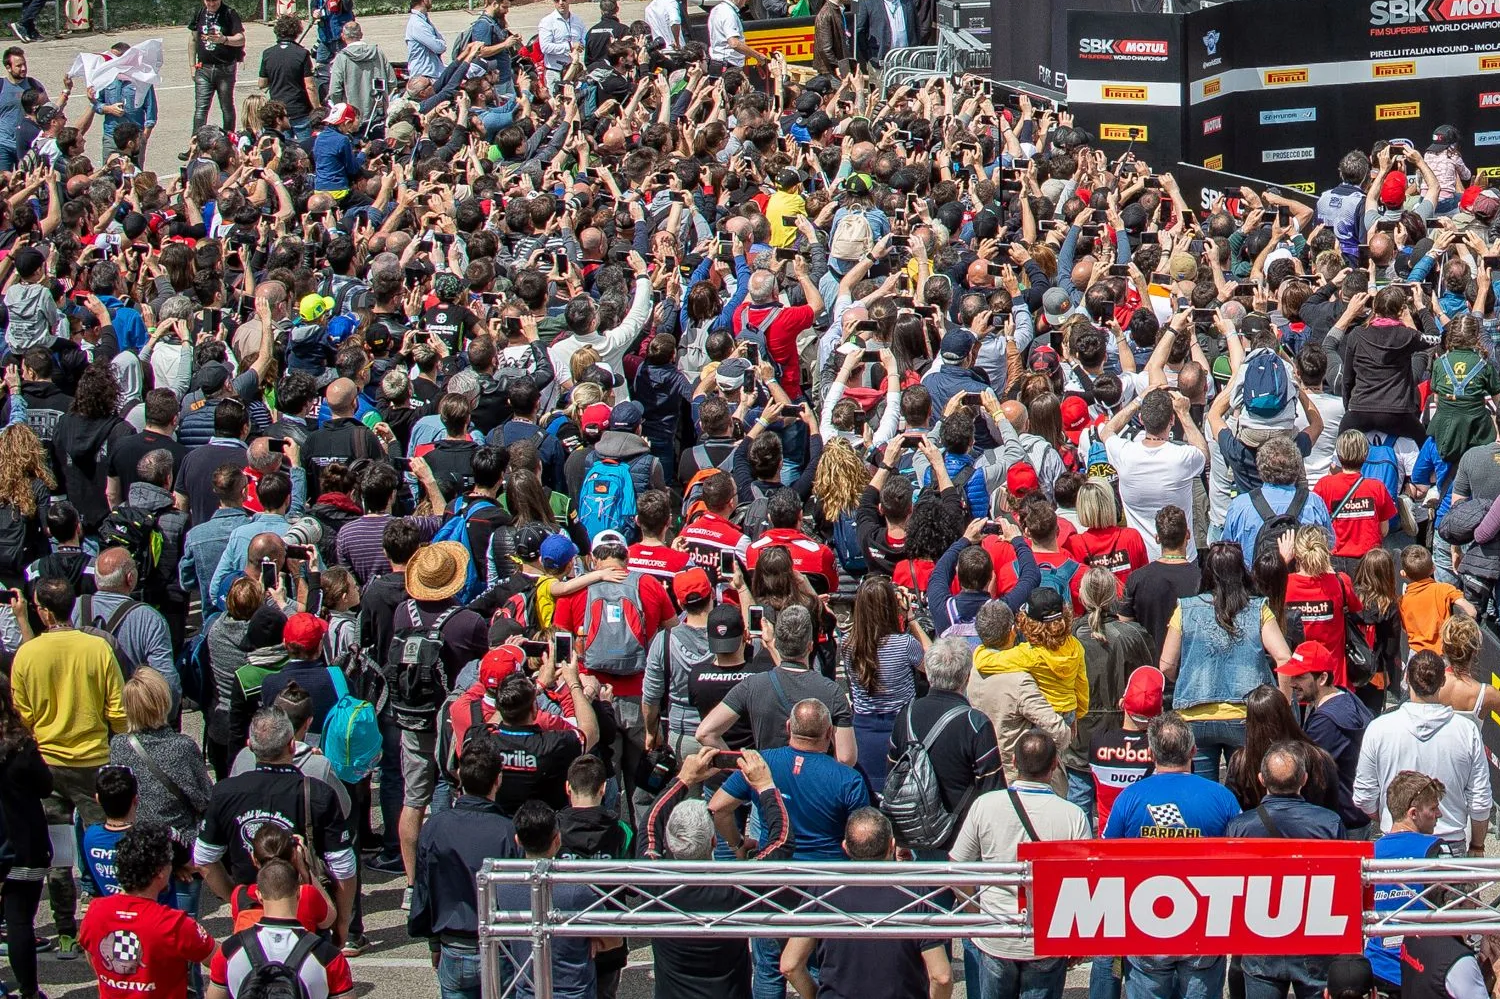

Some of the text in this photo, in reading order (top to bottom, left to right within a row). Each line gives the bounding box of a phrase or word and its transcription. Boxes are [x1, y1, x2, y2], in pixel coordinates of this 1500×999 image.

[1370, 28, 1385, 36] FIM
[1385, 25, 1429, 35] SUPERBIKE
[1430, 23, 1460, 33] WORLD
[1079, 38, 1166, 54] SBK MOTUL
[1370, 50, 1401, 59] PIRELLI
[1402, 47, 1436, 56] ITALIAN
[1437, 45, 1468, 54] ROUND
[1376, 64, 1414, 76] PIRELLI
[1268, 71, 1306, 83] PIRELLI
[1105, 87, 1145, 99] PIRELLI
[1273, 112, 1298, 120] HYUNDAI
[1379, 105, 1417, 117] PIRELLI
[1272, 149, 1313, 160] PROSECCO DOC
[1140, 825, 1202, 839] BARDAHL
[1047, 874, 1348, 939] MOTUL
[99, 974, 157, 992] CAGIVA
